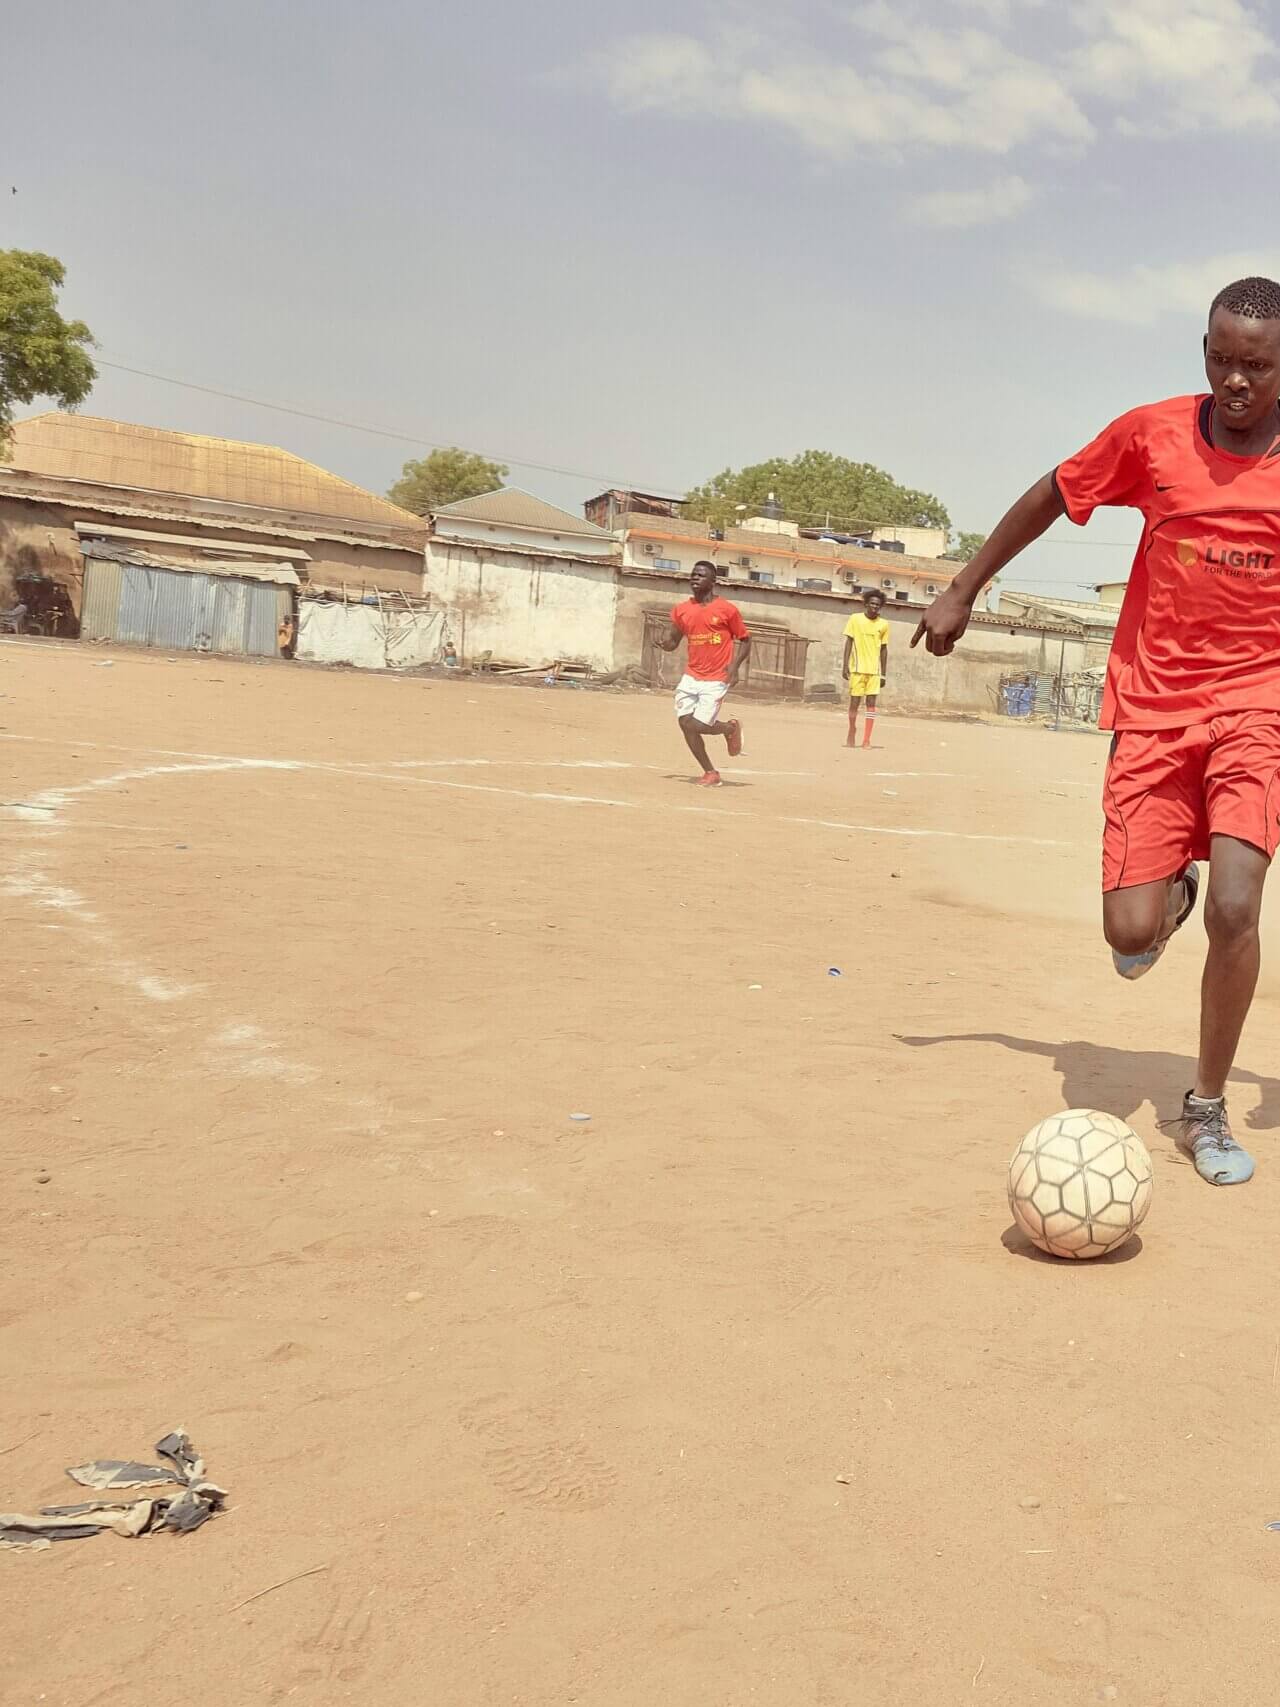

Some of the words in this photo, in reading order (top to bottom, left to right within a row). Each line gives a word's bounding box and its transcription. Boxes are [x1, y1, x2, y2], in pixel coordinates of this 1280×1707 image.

[1206, 547, 1275, 569] LIGHT
[1205, 566, 1224, 575] FOR
[1225, 568, 1241, 577] THE
[1244, 570, 1272, 579] WORLD
